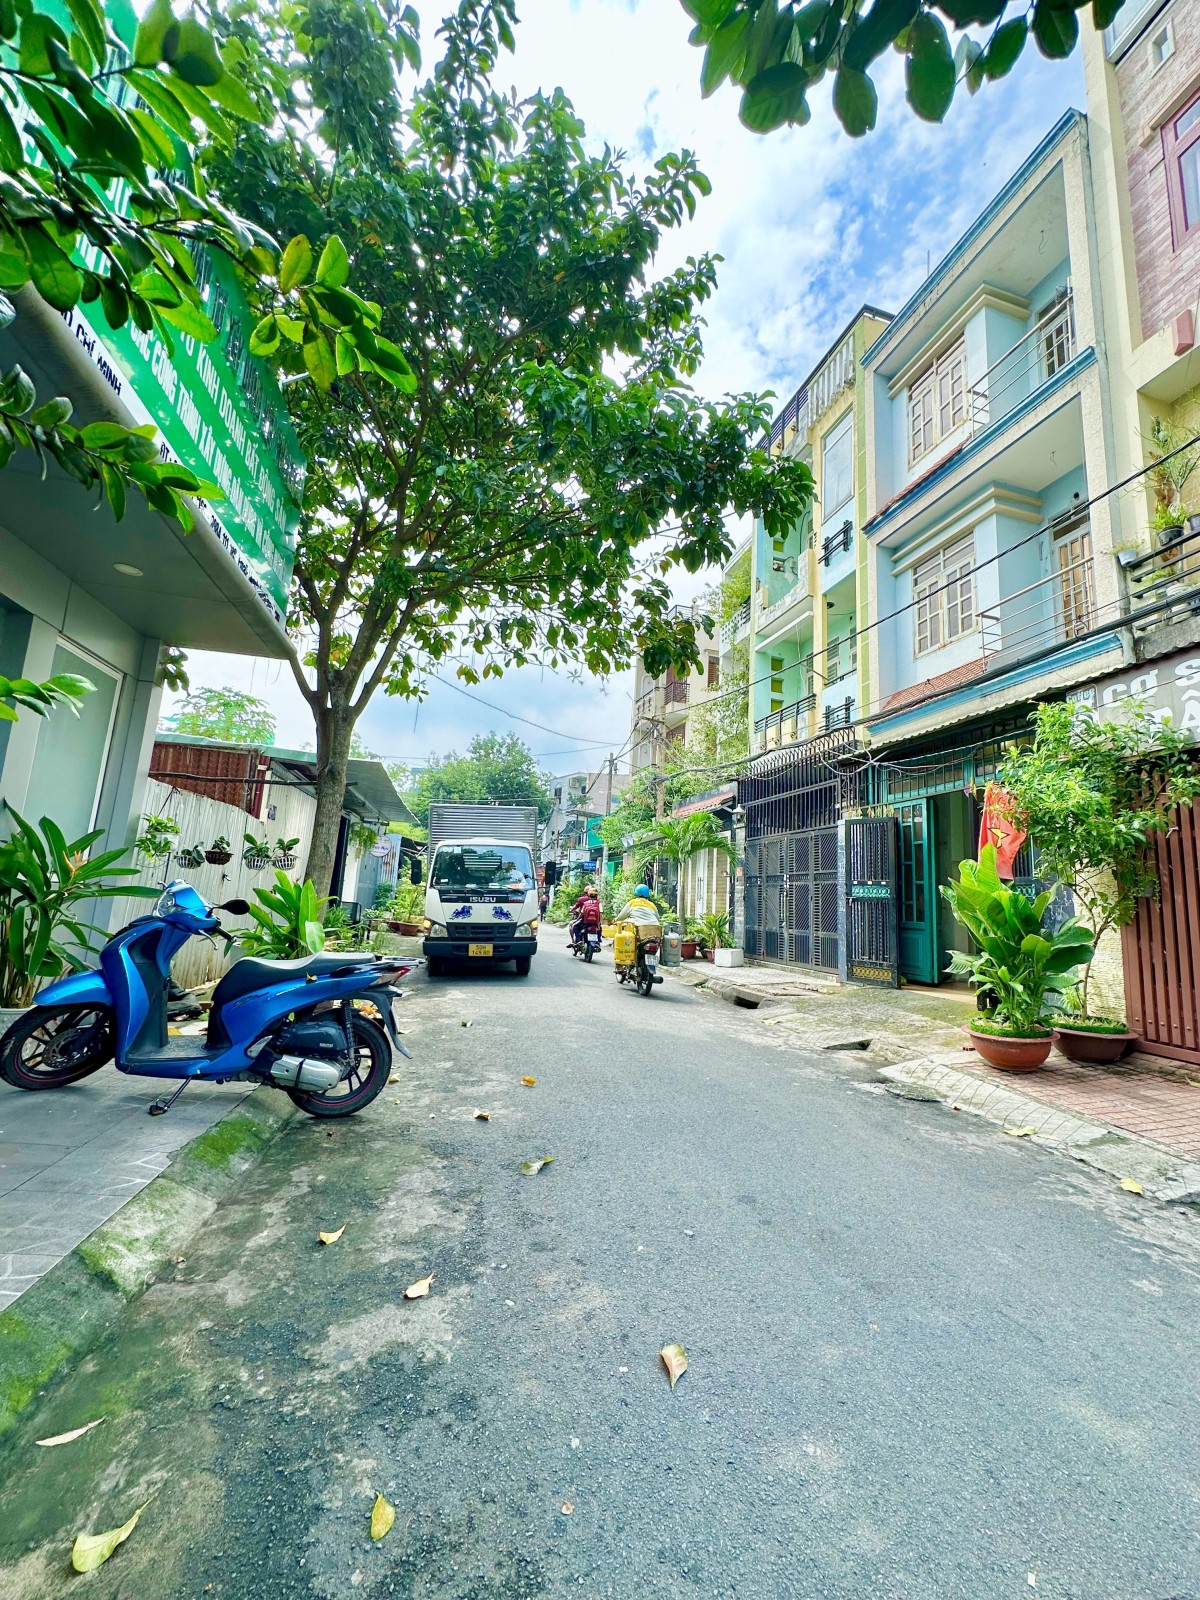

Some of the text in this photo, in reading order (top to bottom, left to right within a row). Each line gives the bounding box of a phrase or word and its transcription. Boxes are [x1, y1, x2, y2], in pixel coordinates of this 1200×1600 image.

[176, 380, 201, 445] TRÌNH
[198, 421, 216, 468] XÂY
[195, 340, 220, 405] KINH
[218, 386, 246, 457] DOANH
[1066, 688, 1095, 703] Coffee
